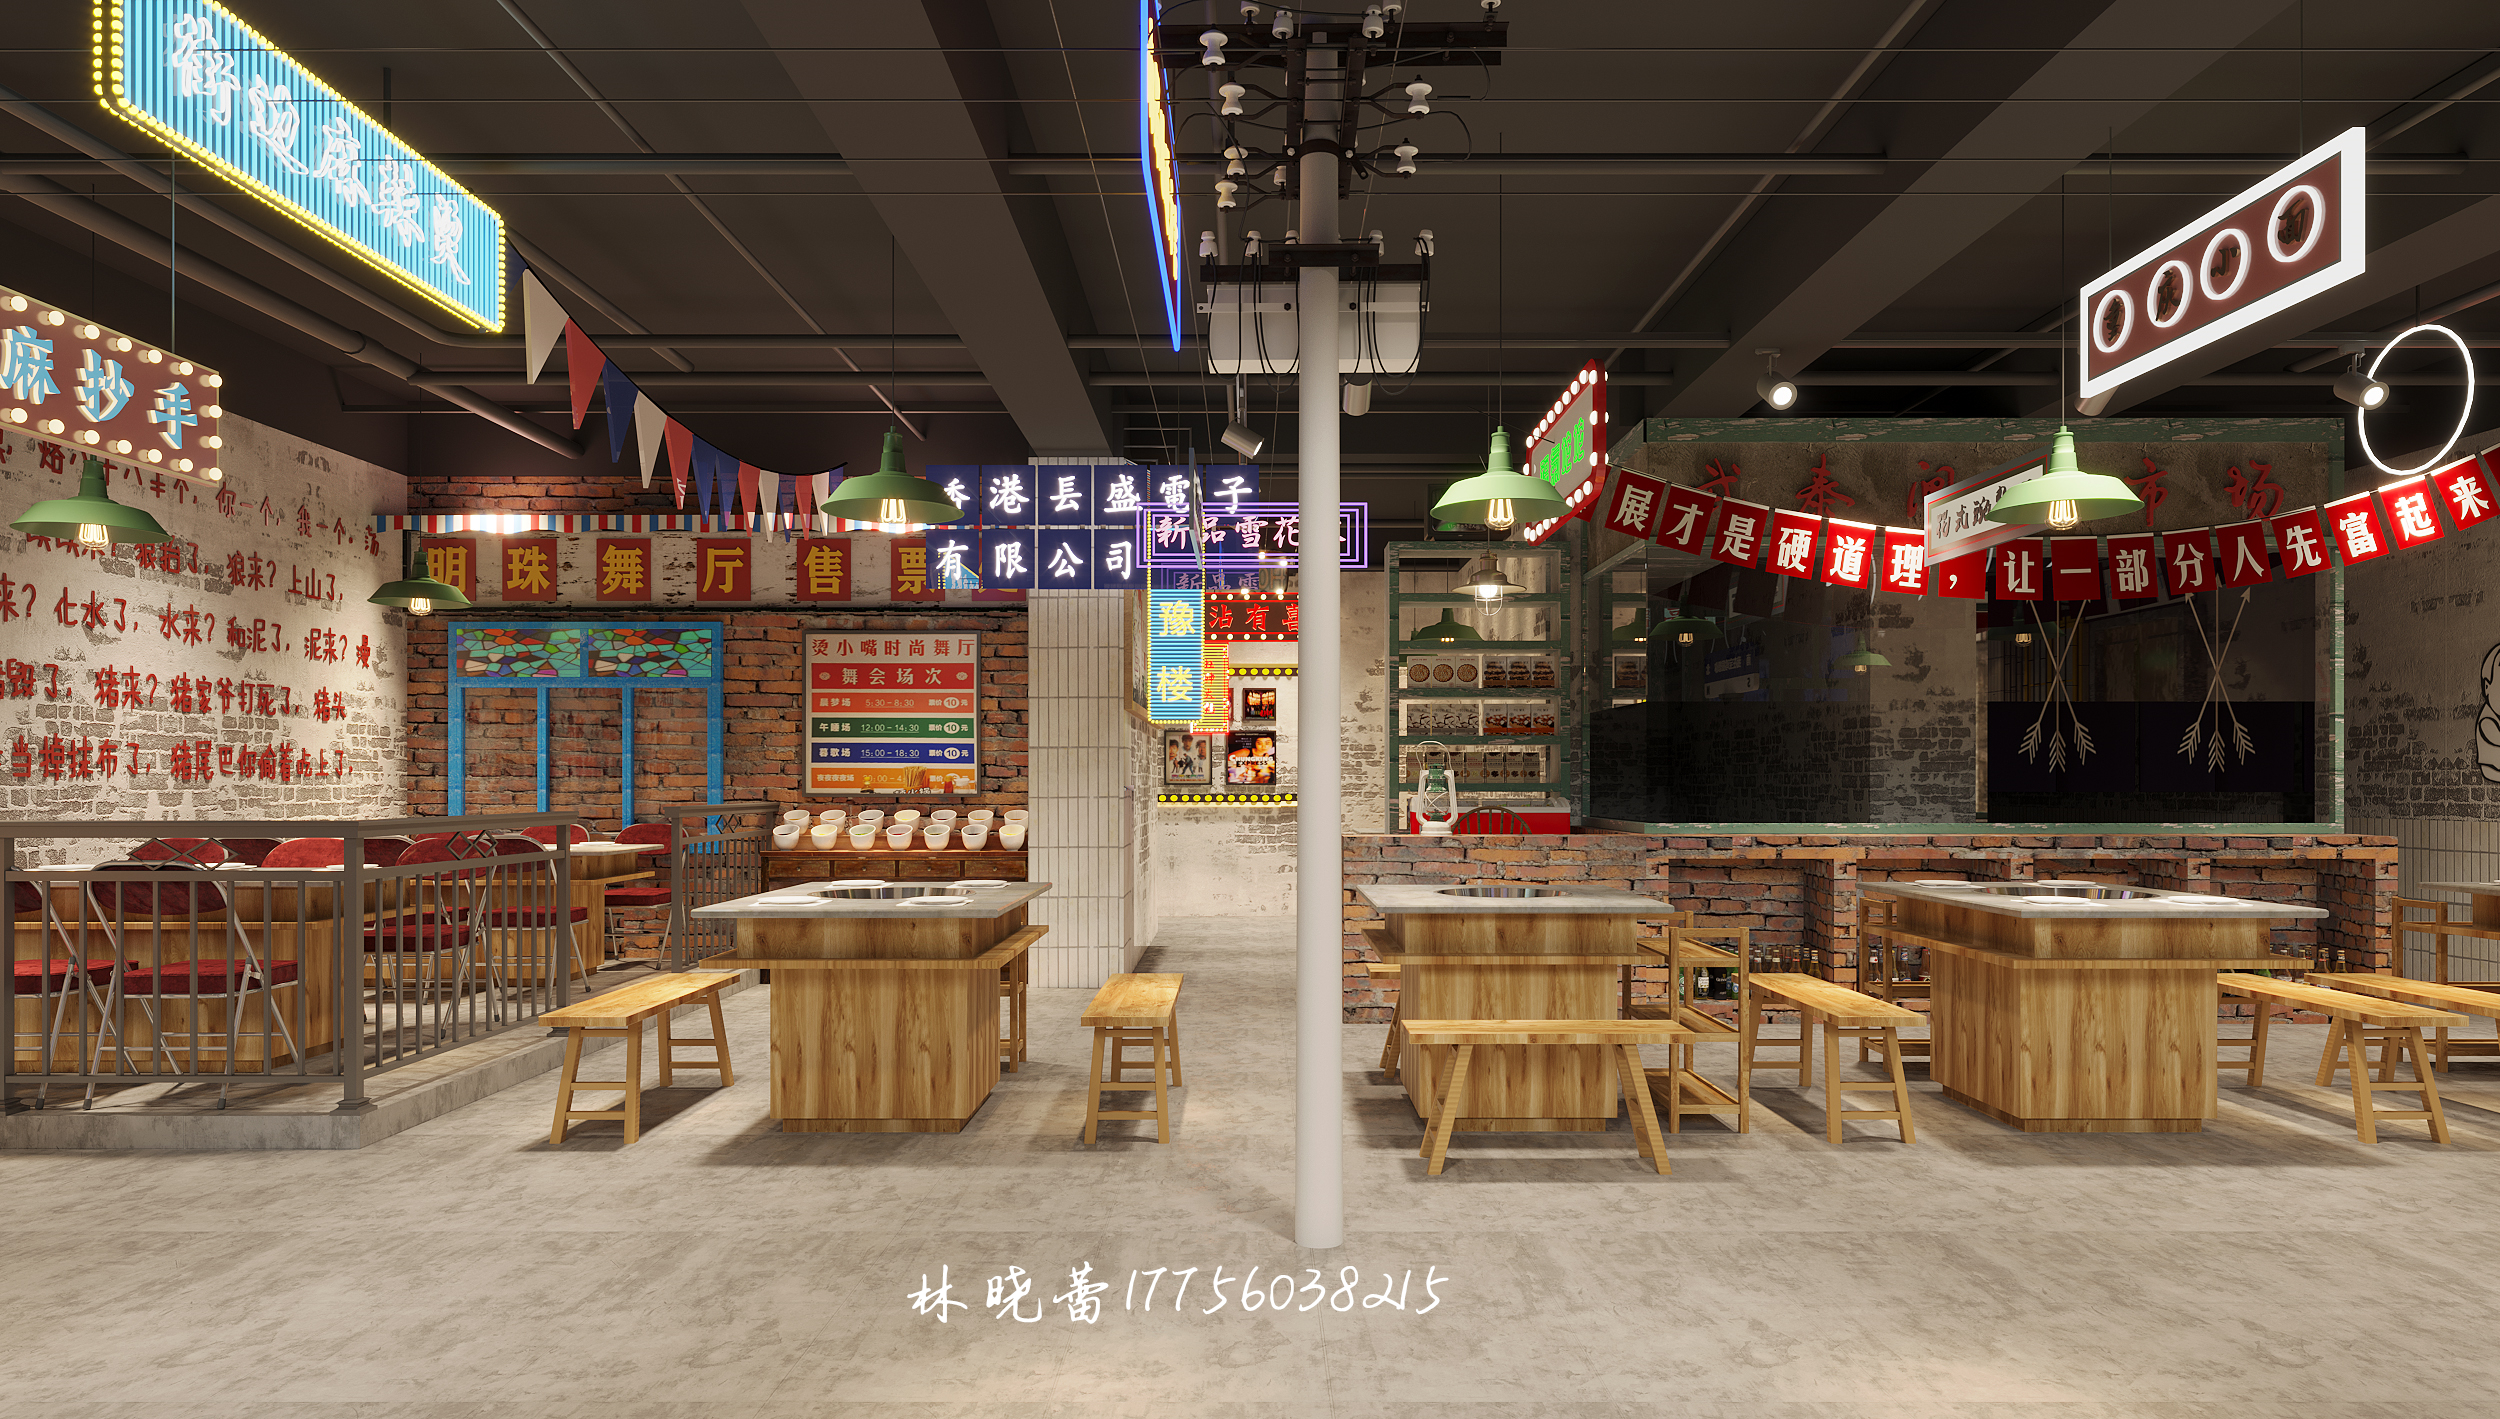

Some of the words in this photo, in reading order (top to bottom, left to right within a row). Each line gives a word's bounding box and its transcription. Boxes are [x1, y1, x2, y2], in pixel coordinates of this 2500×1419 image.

[2103, 198, 2309, 342] 重庆小面
[0, 325, 199, 450] 麻抄手
[1155, 515, 1347, 549] 新品雪花
[429, 546, 1018, 595] 明珠舞厅售票
[936, 539, 1132, 580] 有限公司
[811, 638, 975, 657] 烫小嘴时尚舞厅
[842, 667, 942, 686] 舞会场次
